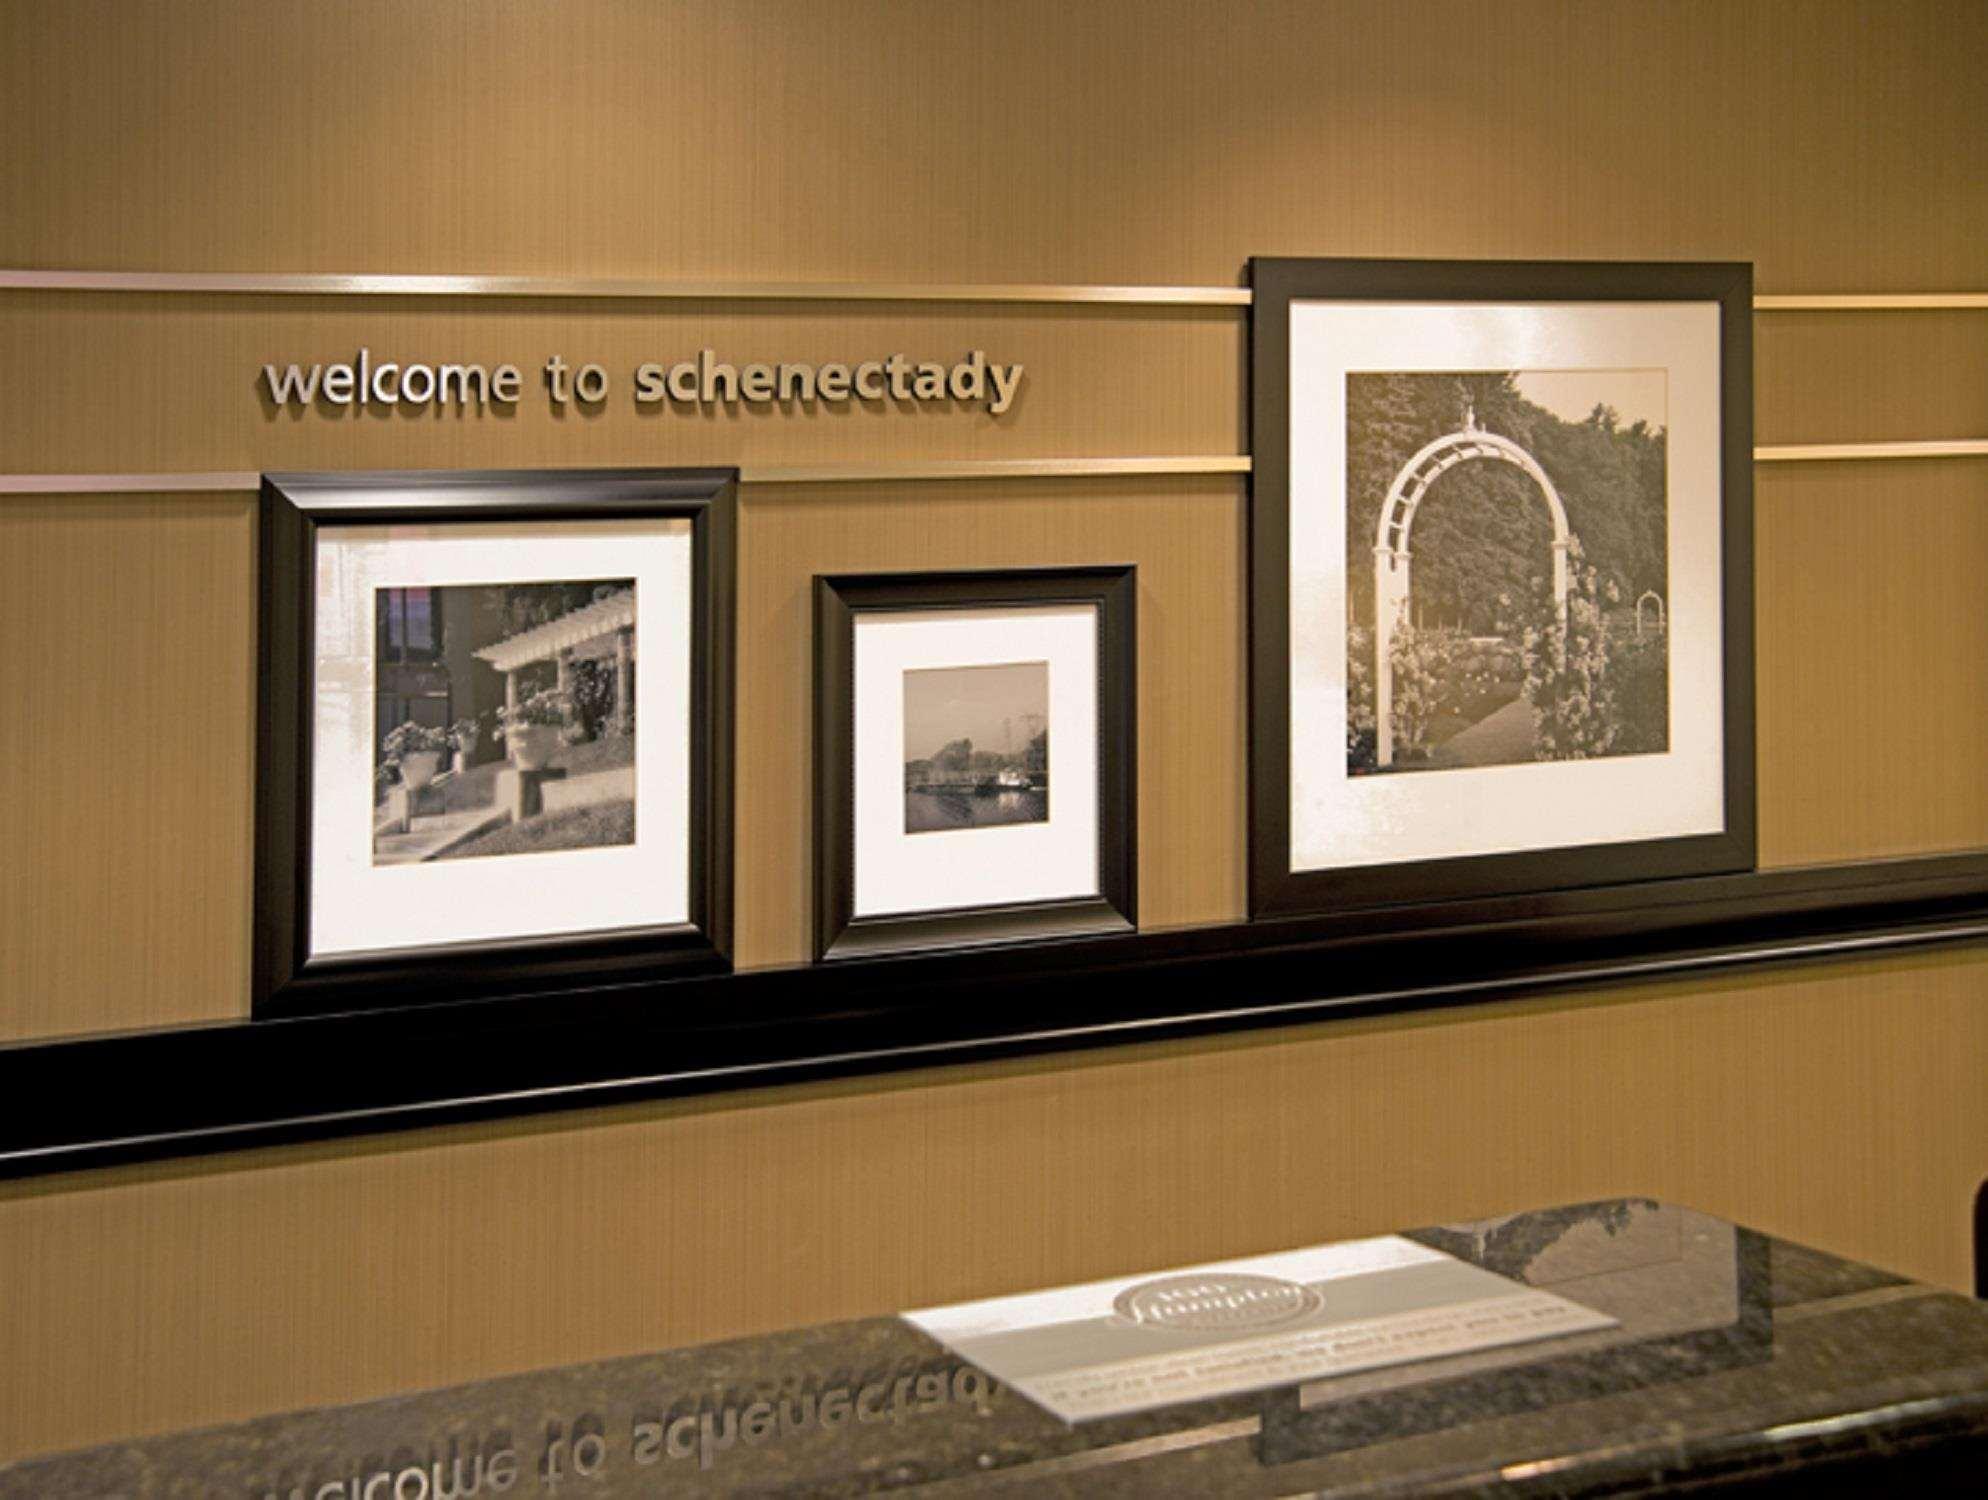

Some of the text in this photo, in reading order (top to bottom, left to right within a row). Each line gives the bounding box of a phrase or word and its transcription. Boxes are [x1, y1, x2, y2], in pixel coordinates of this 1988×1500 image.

[264, 348, 1023, 413] welcome to schenectady
